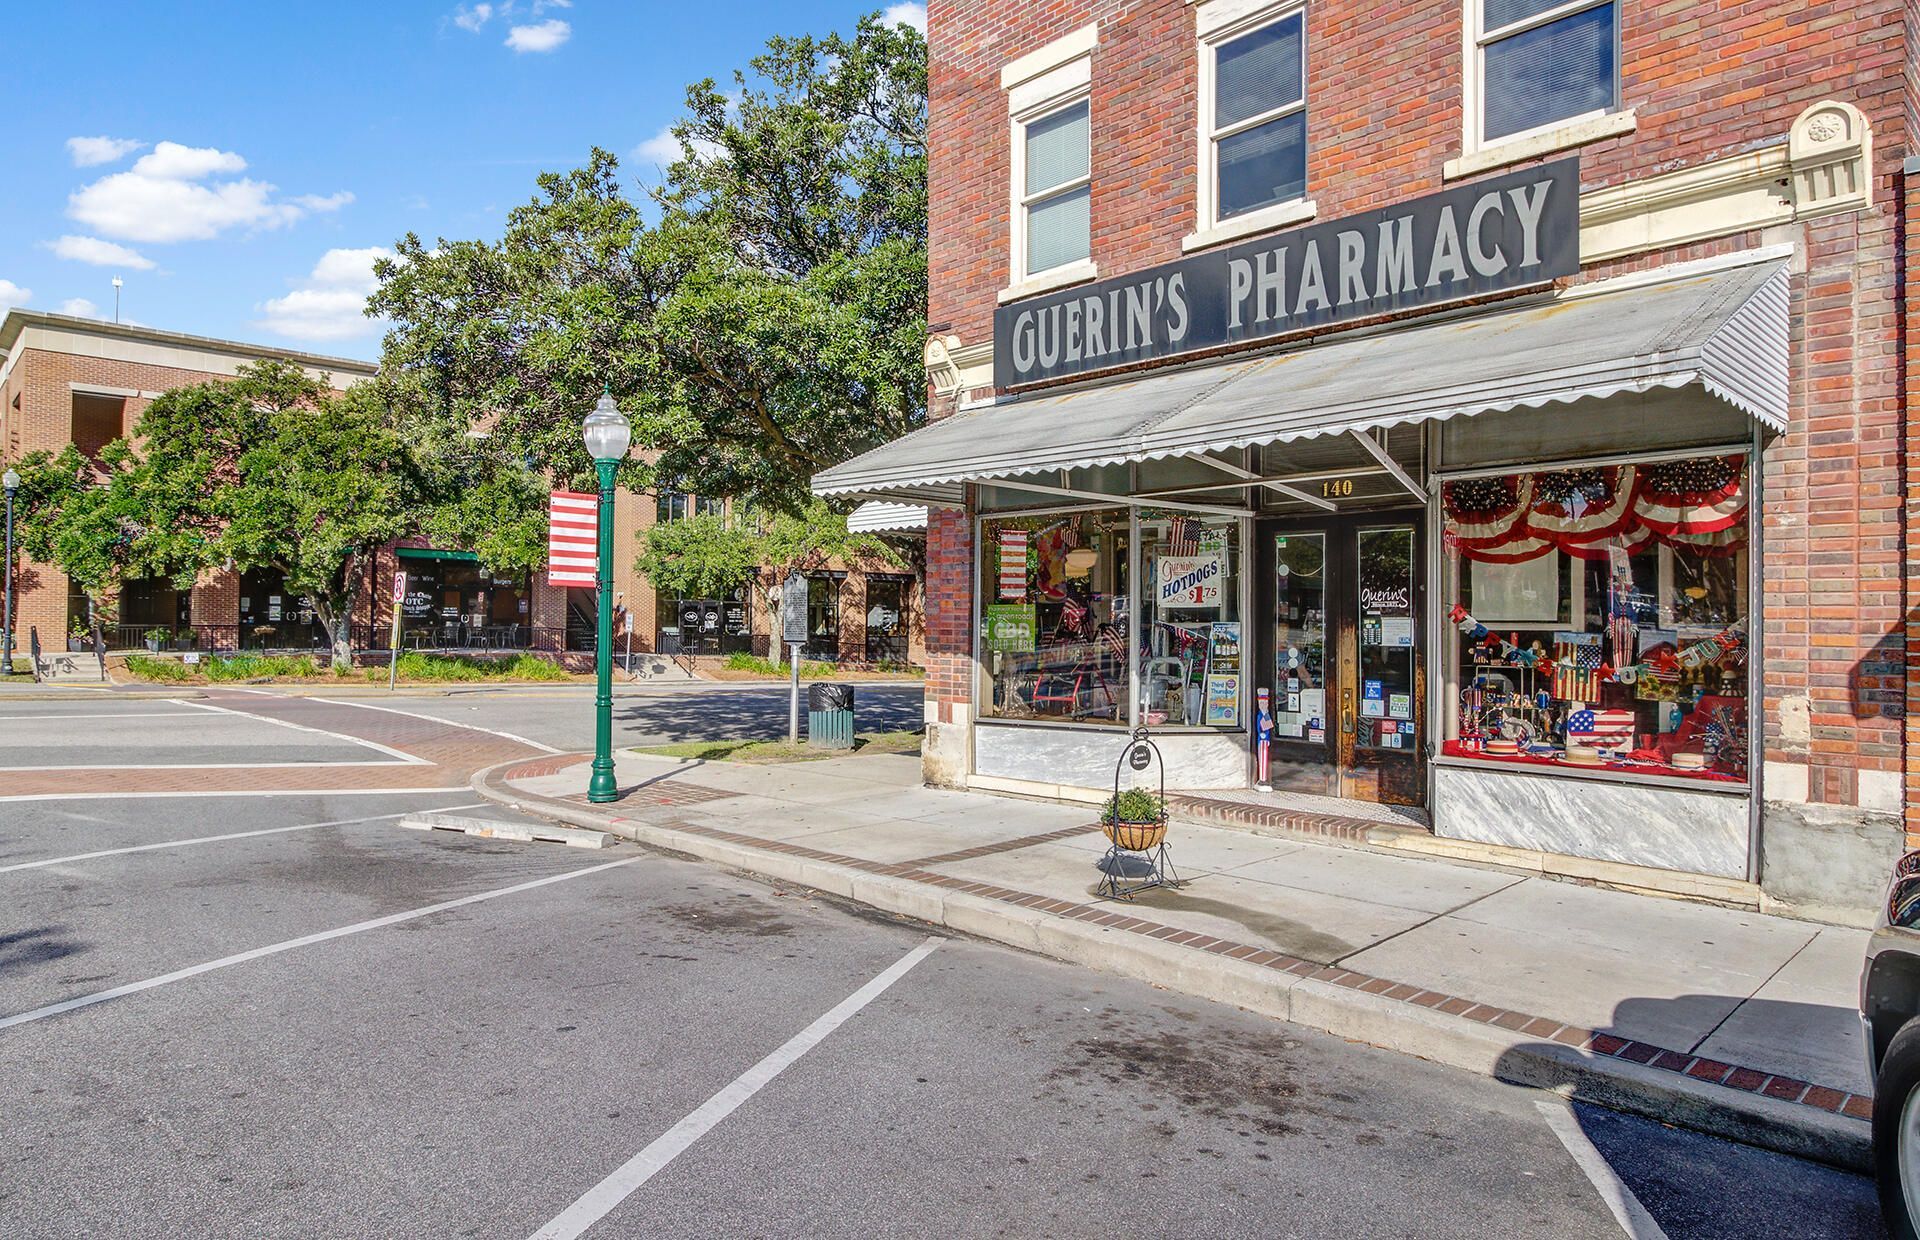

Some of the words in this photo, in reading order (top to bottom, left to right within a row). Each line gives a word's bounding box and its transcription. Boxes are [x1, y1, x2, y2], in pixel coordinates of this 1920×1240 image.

[1012, 271, 1190, 373] GUERIN'S
[1227, 178, 1556, 329] PHARMACY
[1323, 479, 1353, 497] 140
[1162, 560, 1218, 599] HOTDOGS
[405, 597, 424, 606] OTC
[1188, 585, 1217, 604] $1.75
[993, 622, 1030, 639] CBD
[1448, 603, 1517, 659] HAPPY
[988, 639, 1008, 650] SOLD
[1012, 639, 1034, 651] HERE
